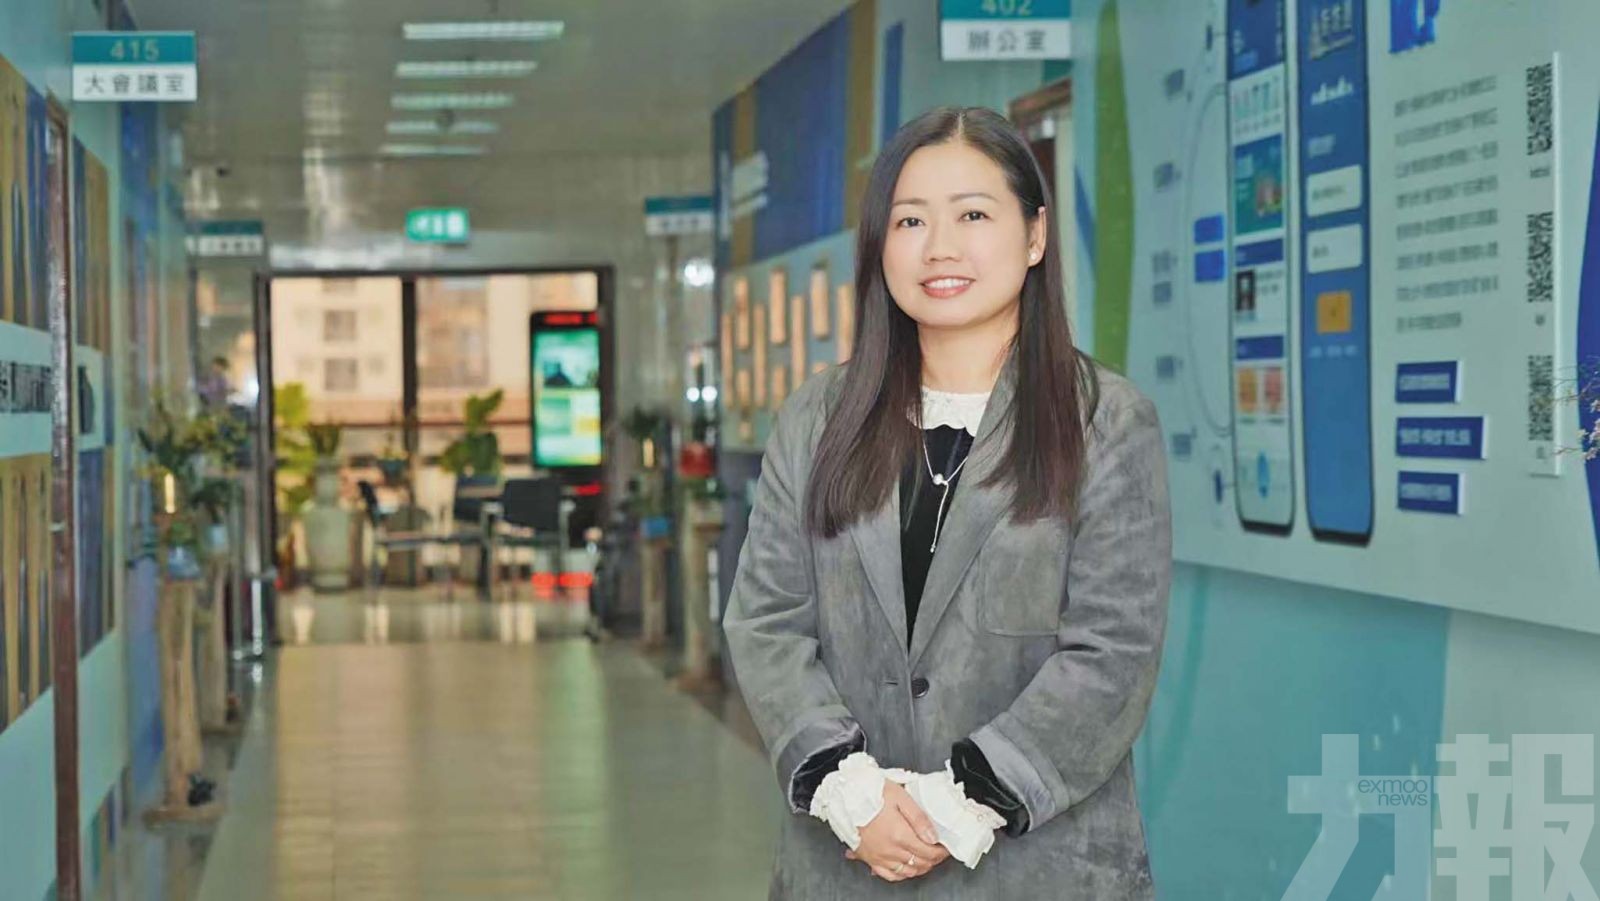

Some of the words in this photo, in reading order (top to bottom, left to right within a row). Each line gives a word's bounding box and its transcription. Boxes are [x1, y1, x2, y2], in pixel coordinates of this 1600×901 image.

[980, 0, 1033, 16] 402
[109, 38, 159, 61] 415
[967, 29, 1046, 52] 辦公室
[83, 71, 184, 95] 大會議室
